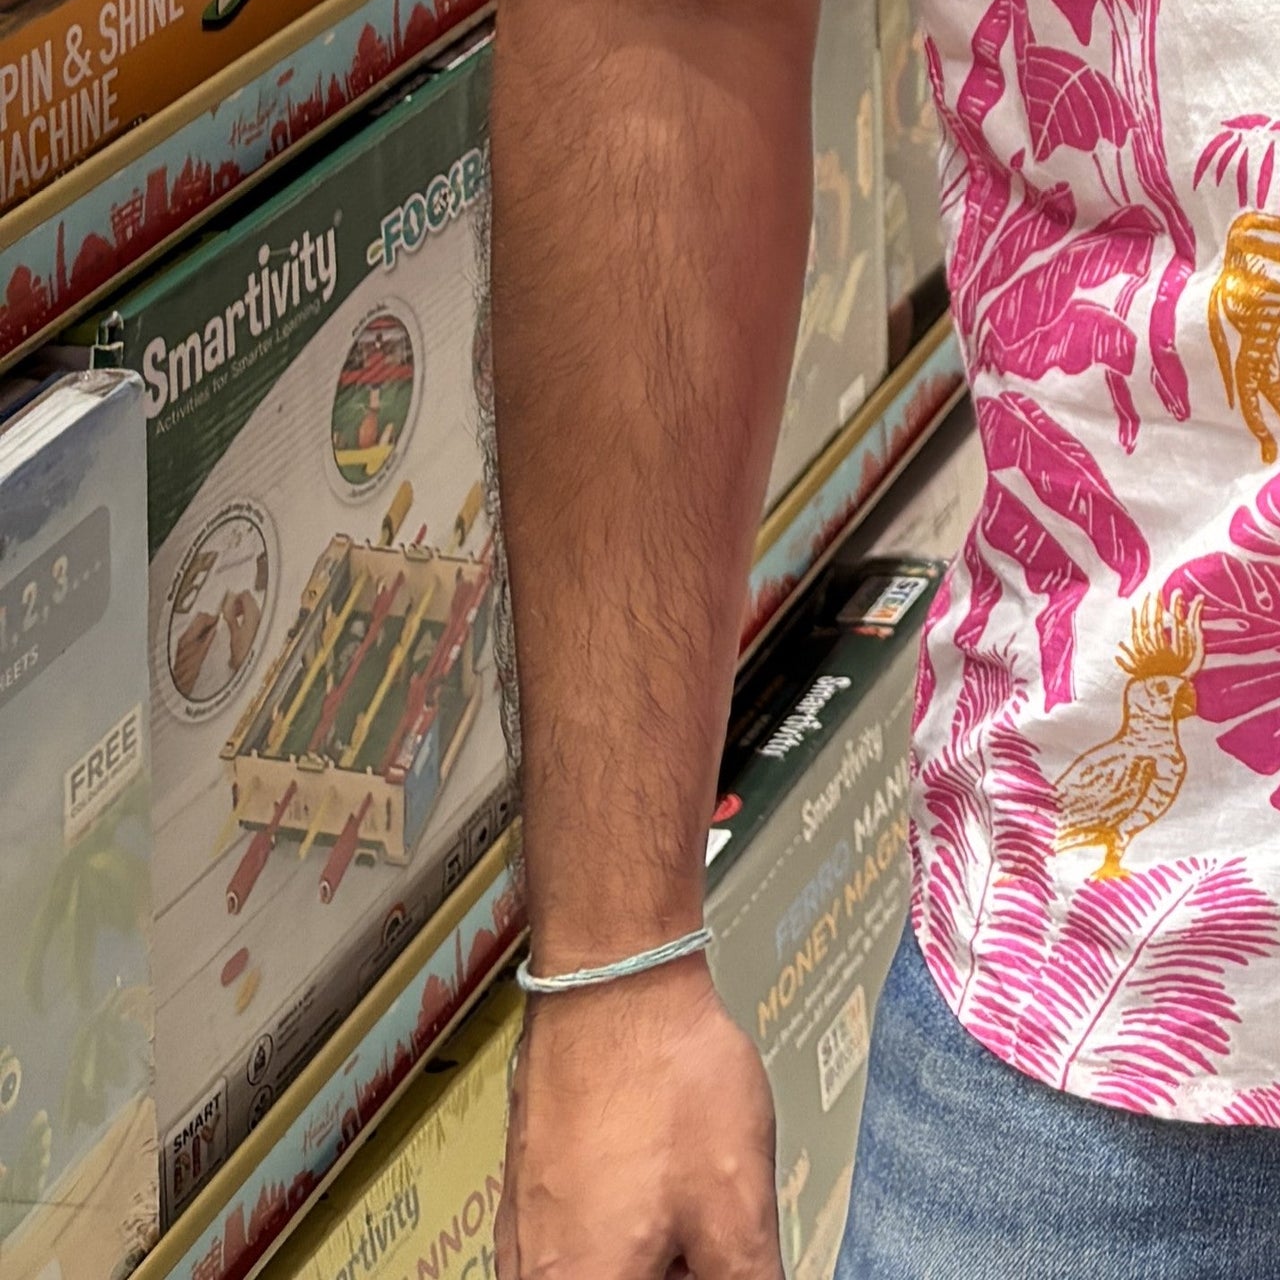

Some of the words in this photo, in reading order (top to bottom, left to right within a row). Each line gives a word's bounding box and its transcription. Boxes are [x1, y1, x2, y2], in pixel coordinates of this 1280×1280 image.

[63, 24, 93, 89] &
[0, 67, 120, 202] ACHINE
[142, 226, 338, 420] Smartivity
[155, 388, 210, 436] Activities
[212, 372, 229, 393] for
[230, 333, 273, 377] Smarter
[70, 714, 138, 805] FREE
[758, 897, 841, 1040] MONEY
[173, 1091, 222, 1154] SMART
